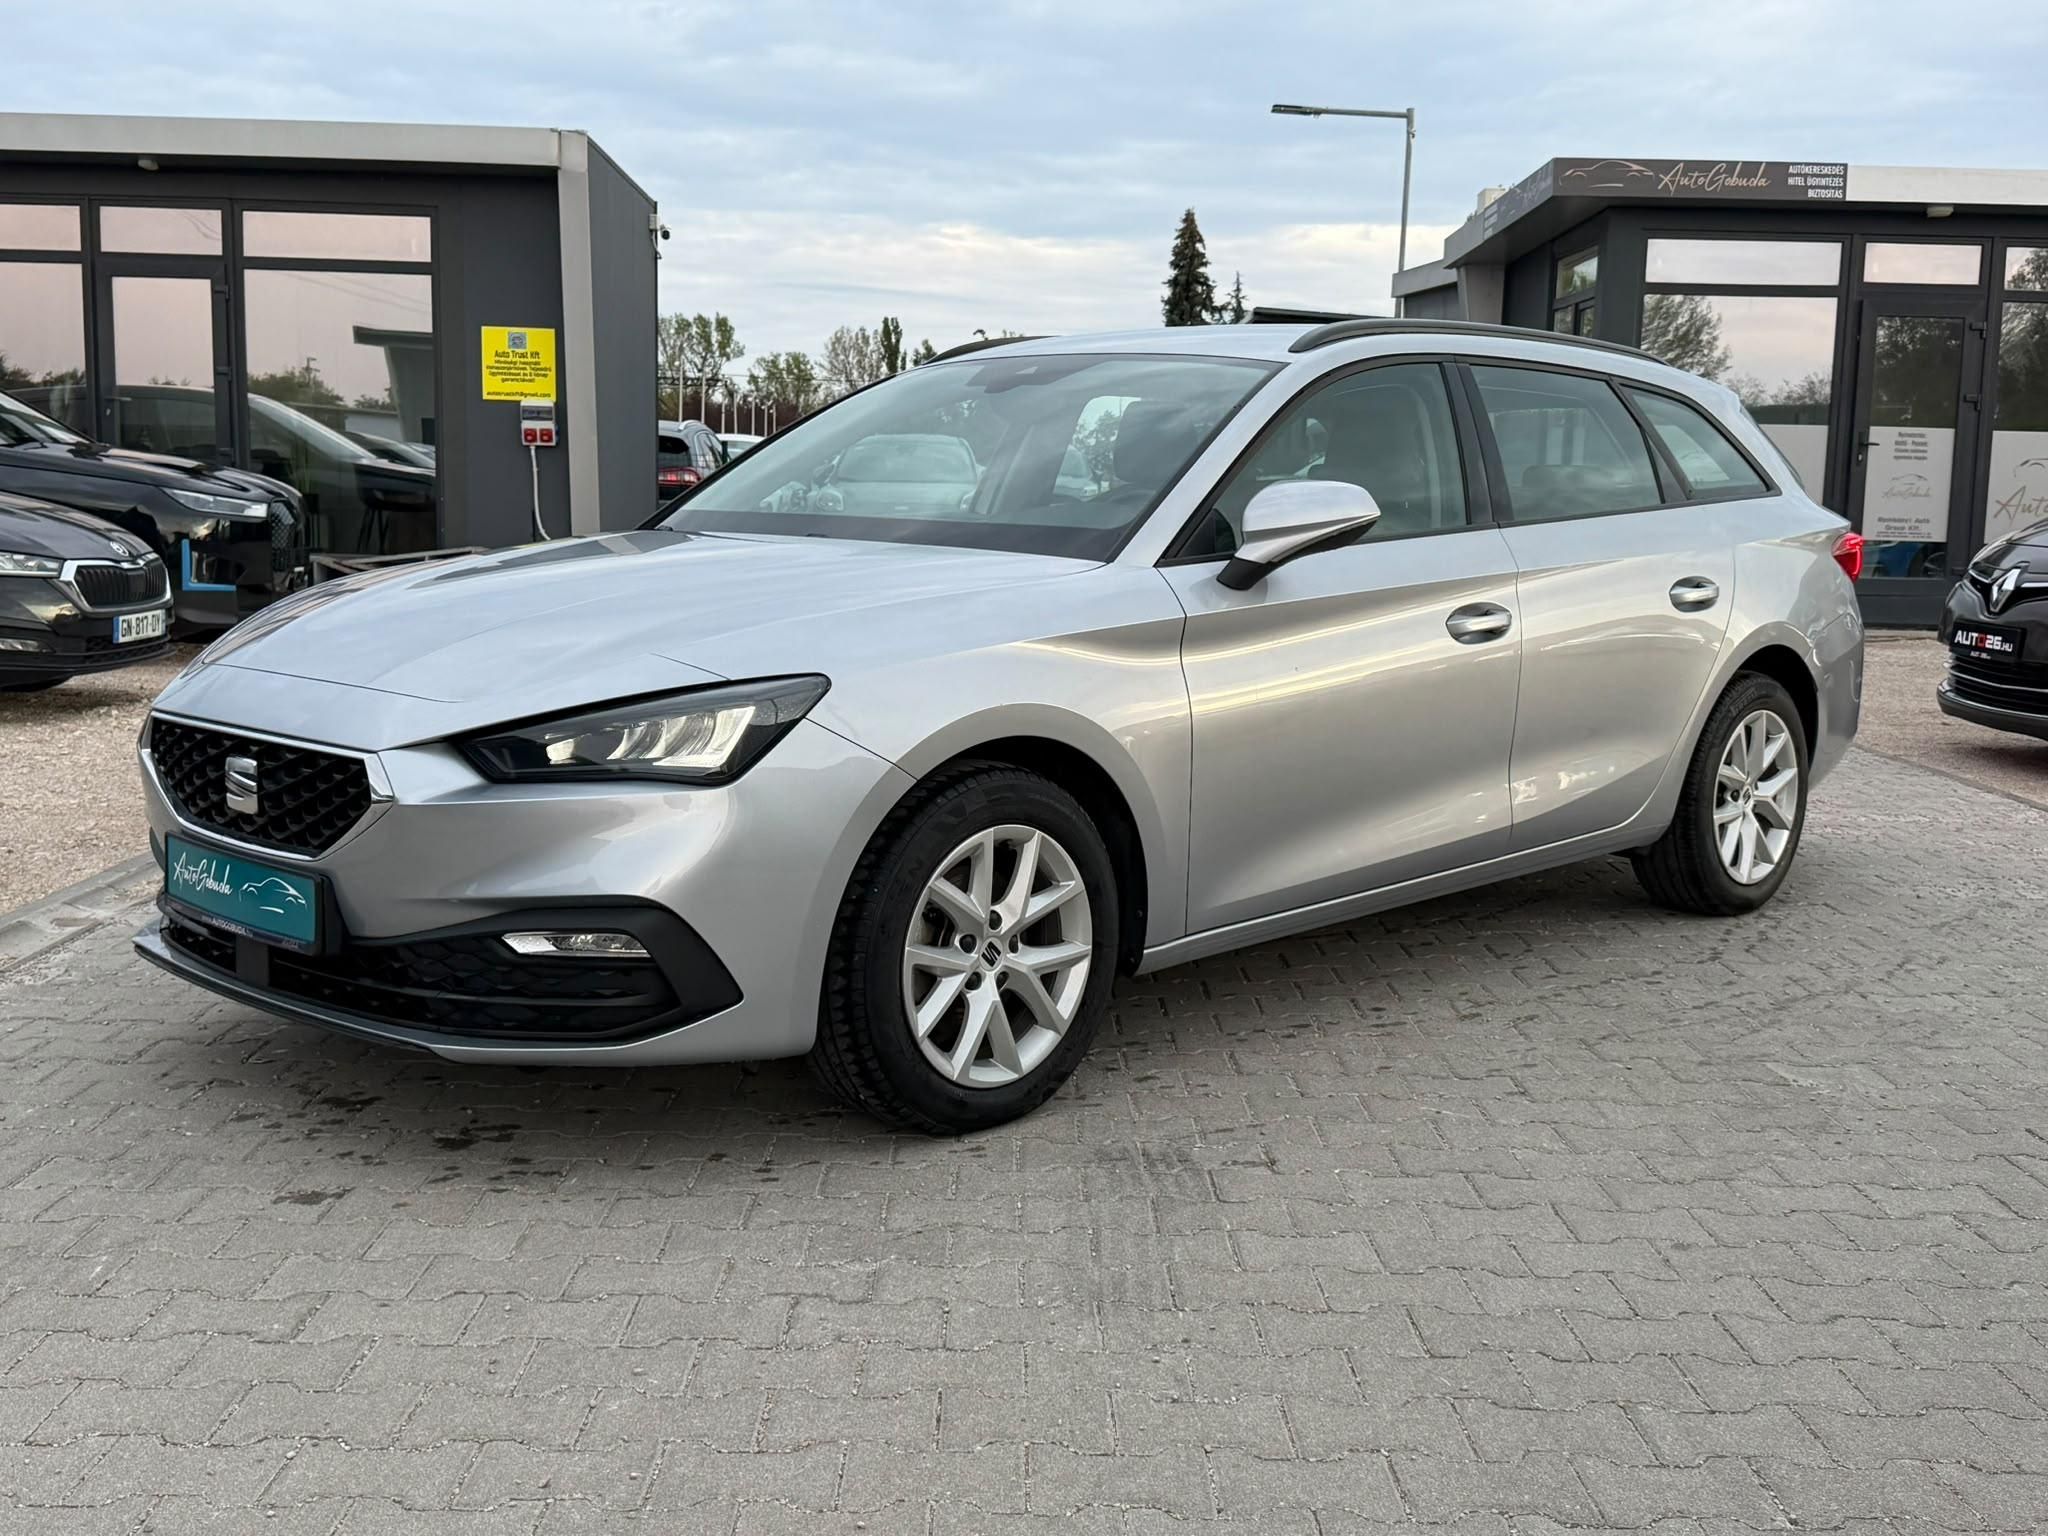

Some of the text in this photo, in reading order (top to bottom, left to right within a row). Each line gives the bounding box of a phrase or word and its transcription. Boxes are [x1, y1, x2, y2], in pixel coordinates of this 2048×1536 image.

[1788, 177, 1806, 187] HITEL
[494, 350, 510, 359] Auto
[511, 350, 528, 360] Trust
